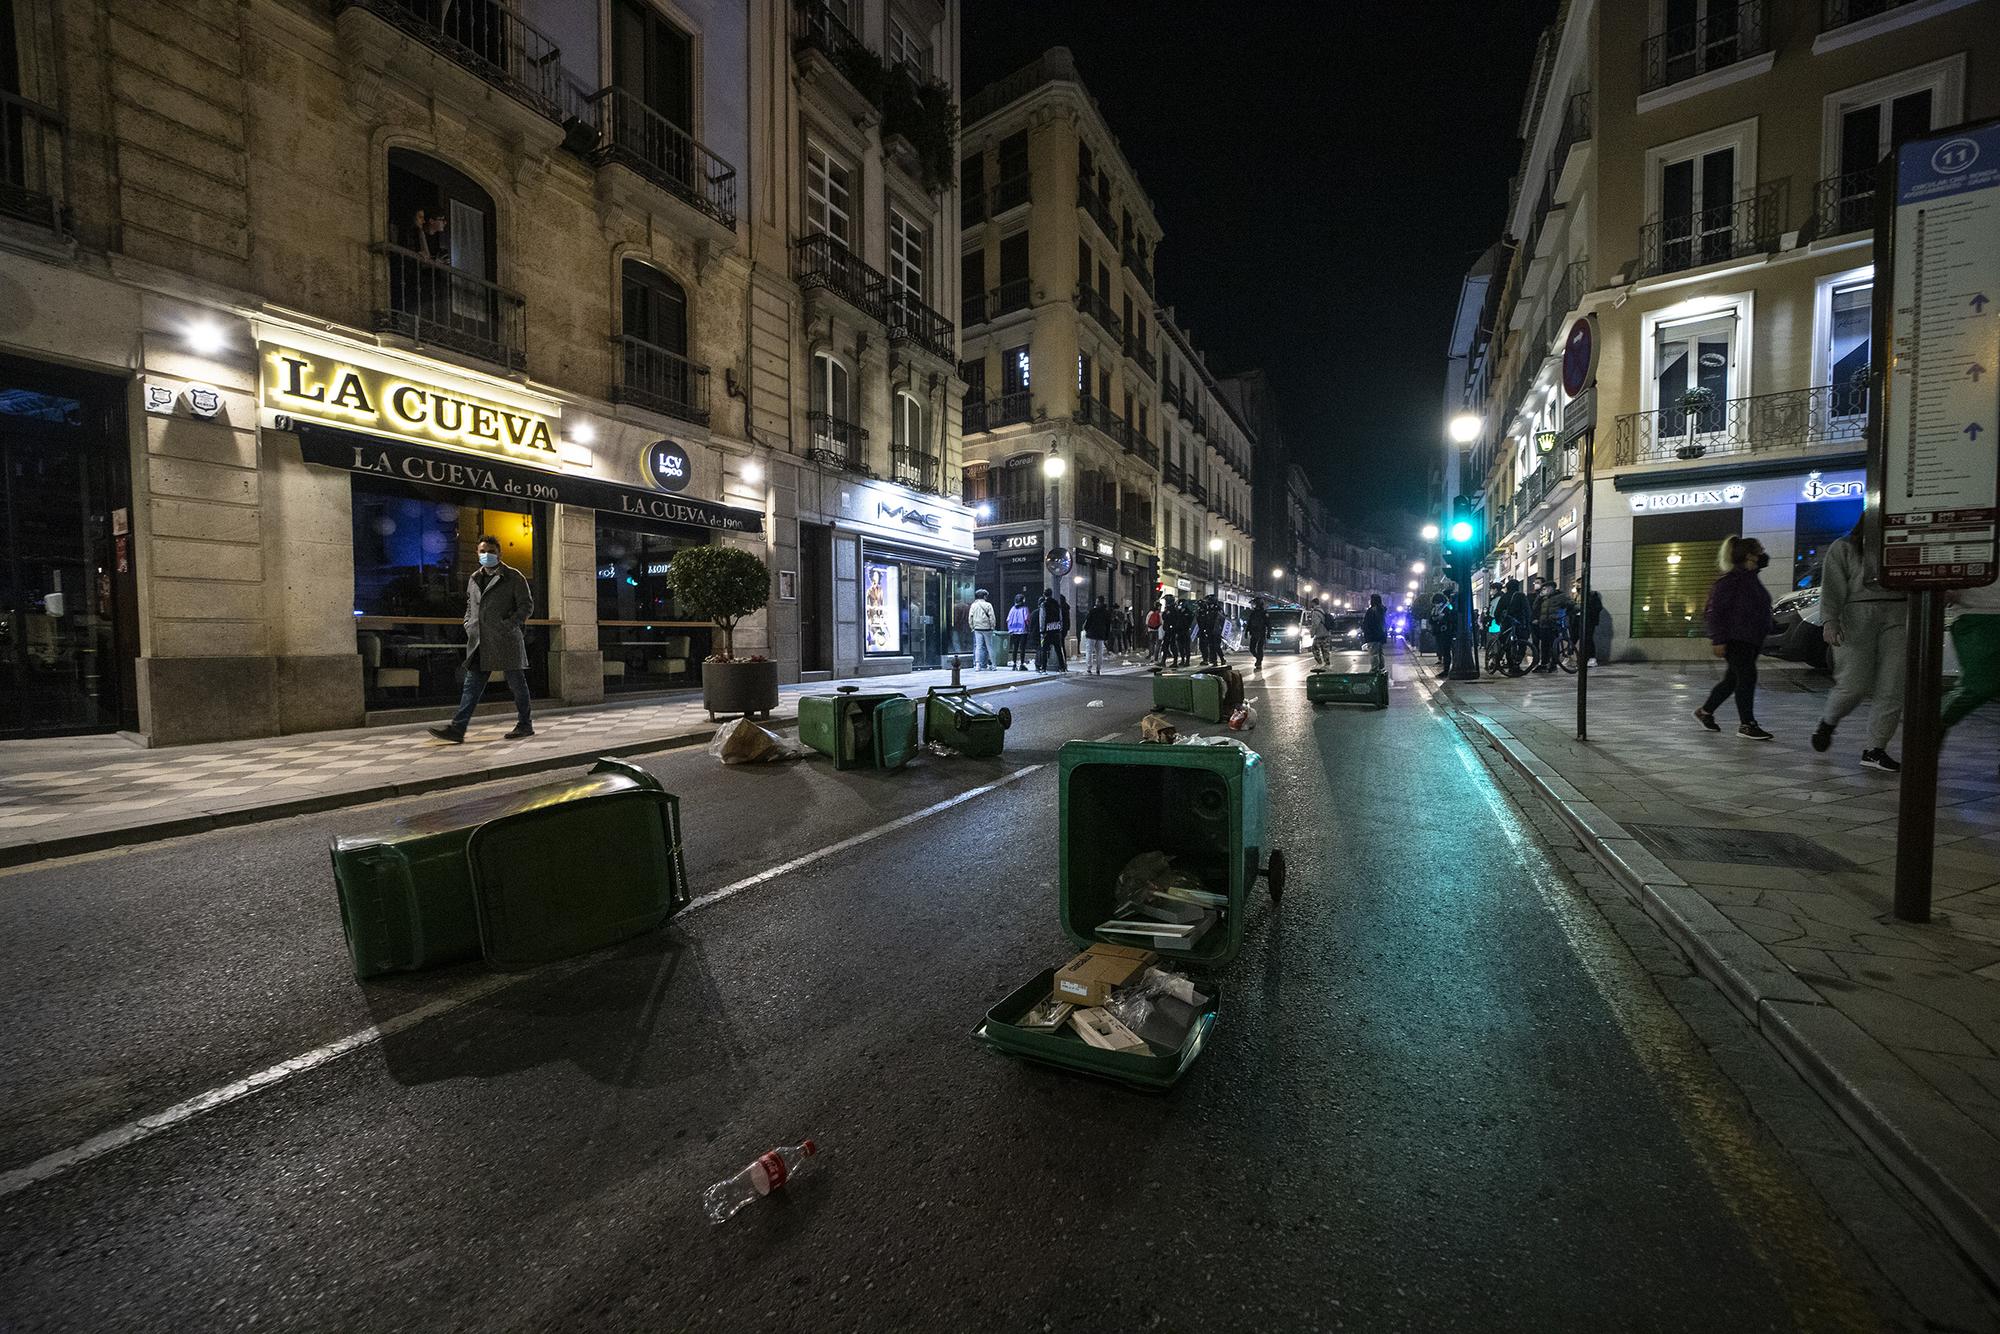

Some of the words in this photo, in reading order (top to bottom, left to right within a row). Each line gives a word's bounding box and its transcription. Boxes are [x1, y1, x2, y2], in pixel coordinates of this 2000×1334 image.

[1942, 148, 1967, 165] 11
[281, 357, 375, 414] LA
[392, 387, 557, 454] CUEVA
[659, 453, 683, 469] LCV
[352, 446, 395, 475] LA
[401, 457, 500, 491] CUEVA
[504, 479, 523, 495] de
[526, 483, 559, 500] 1900
[1652, 490, 1720, 508] ROLEX
[622, 495, 648, 516] LA
[650, 501, 709, 525] CUEVA
[710, 515, 722, 527] de
[723, 518, 744, 530] 1900
[1006, 535, 1038, 548] TOUS
